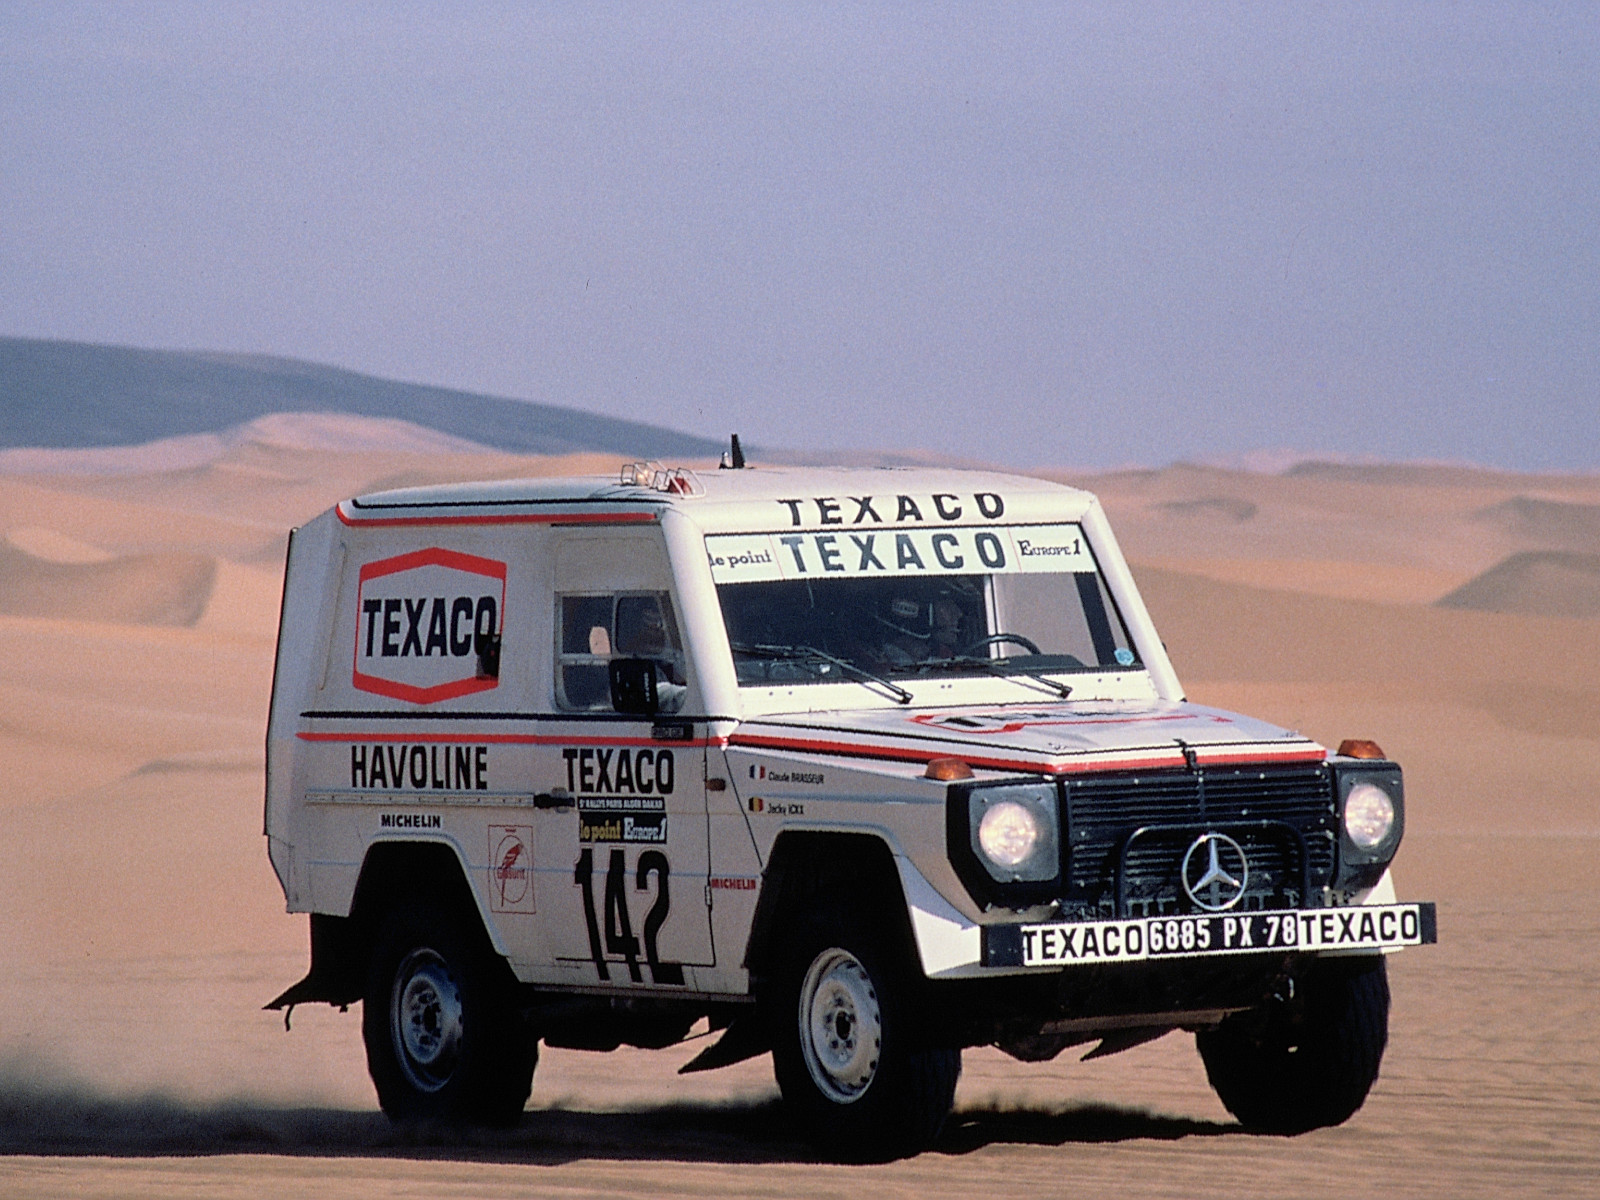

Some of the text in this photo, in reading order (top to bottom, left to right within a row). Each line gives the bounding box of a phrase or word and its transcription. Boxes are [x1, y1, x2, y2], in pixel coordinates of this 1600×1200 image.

[777, 493, 1005, 526] TEXACO
[727, 549, 772, 568] point
[779, 531, 1007, 573] TEXACO
[363, 596, 497, 657] TEXACO
[351, 745, 488, 790] HAVOLINE
[563, 749, 674, 795] TEXACO
[381, 814, 441, 828] MICHELIN
[591, 819, 621, 843] point
[711, 878, 756, 890] MICHELIN
[574, 847, 686, 985] 142
[1148, 914, 1297, 952] 6885 PX 78
[1301, 909, 1419, 945] TEXACO
[1023, 924, 1143, 962] TEXACO
